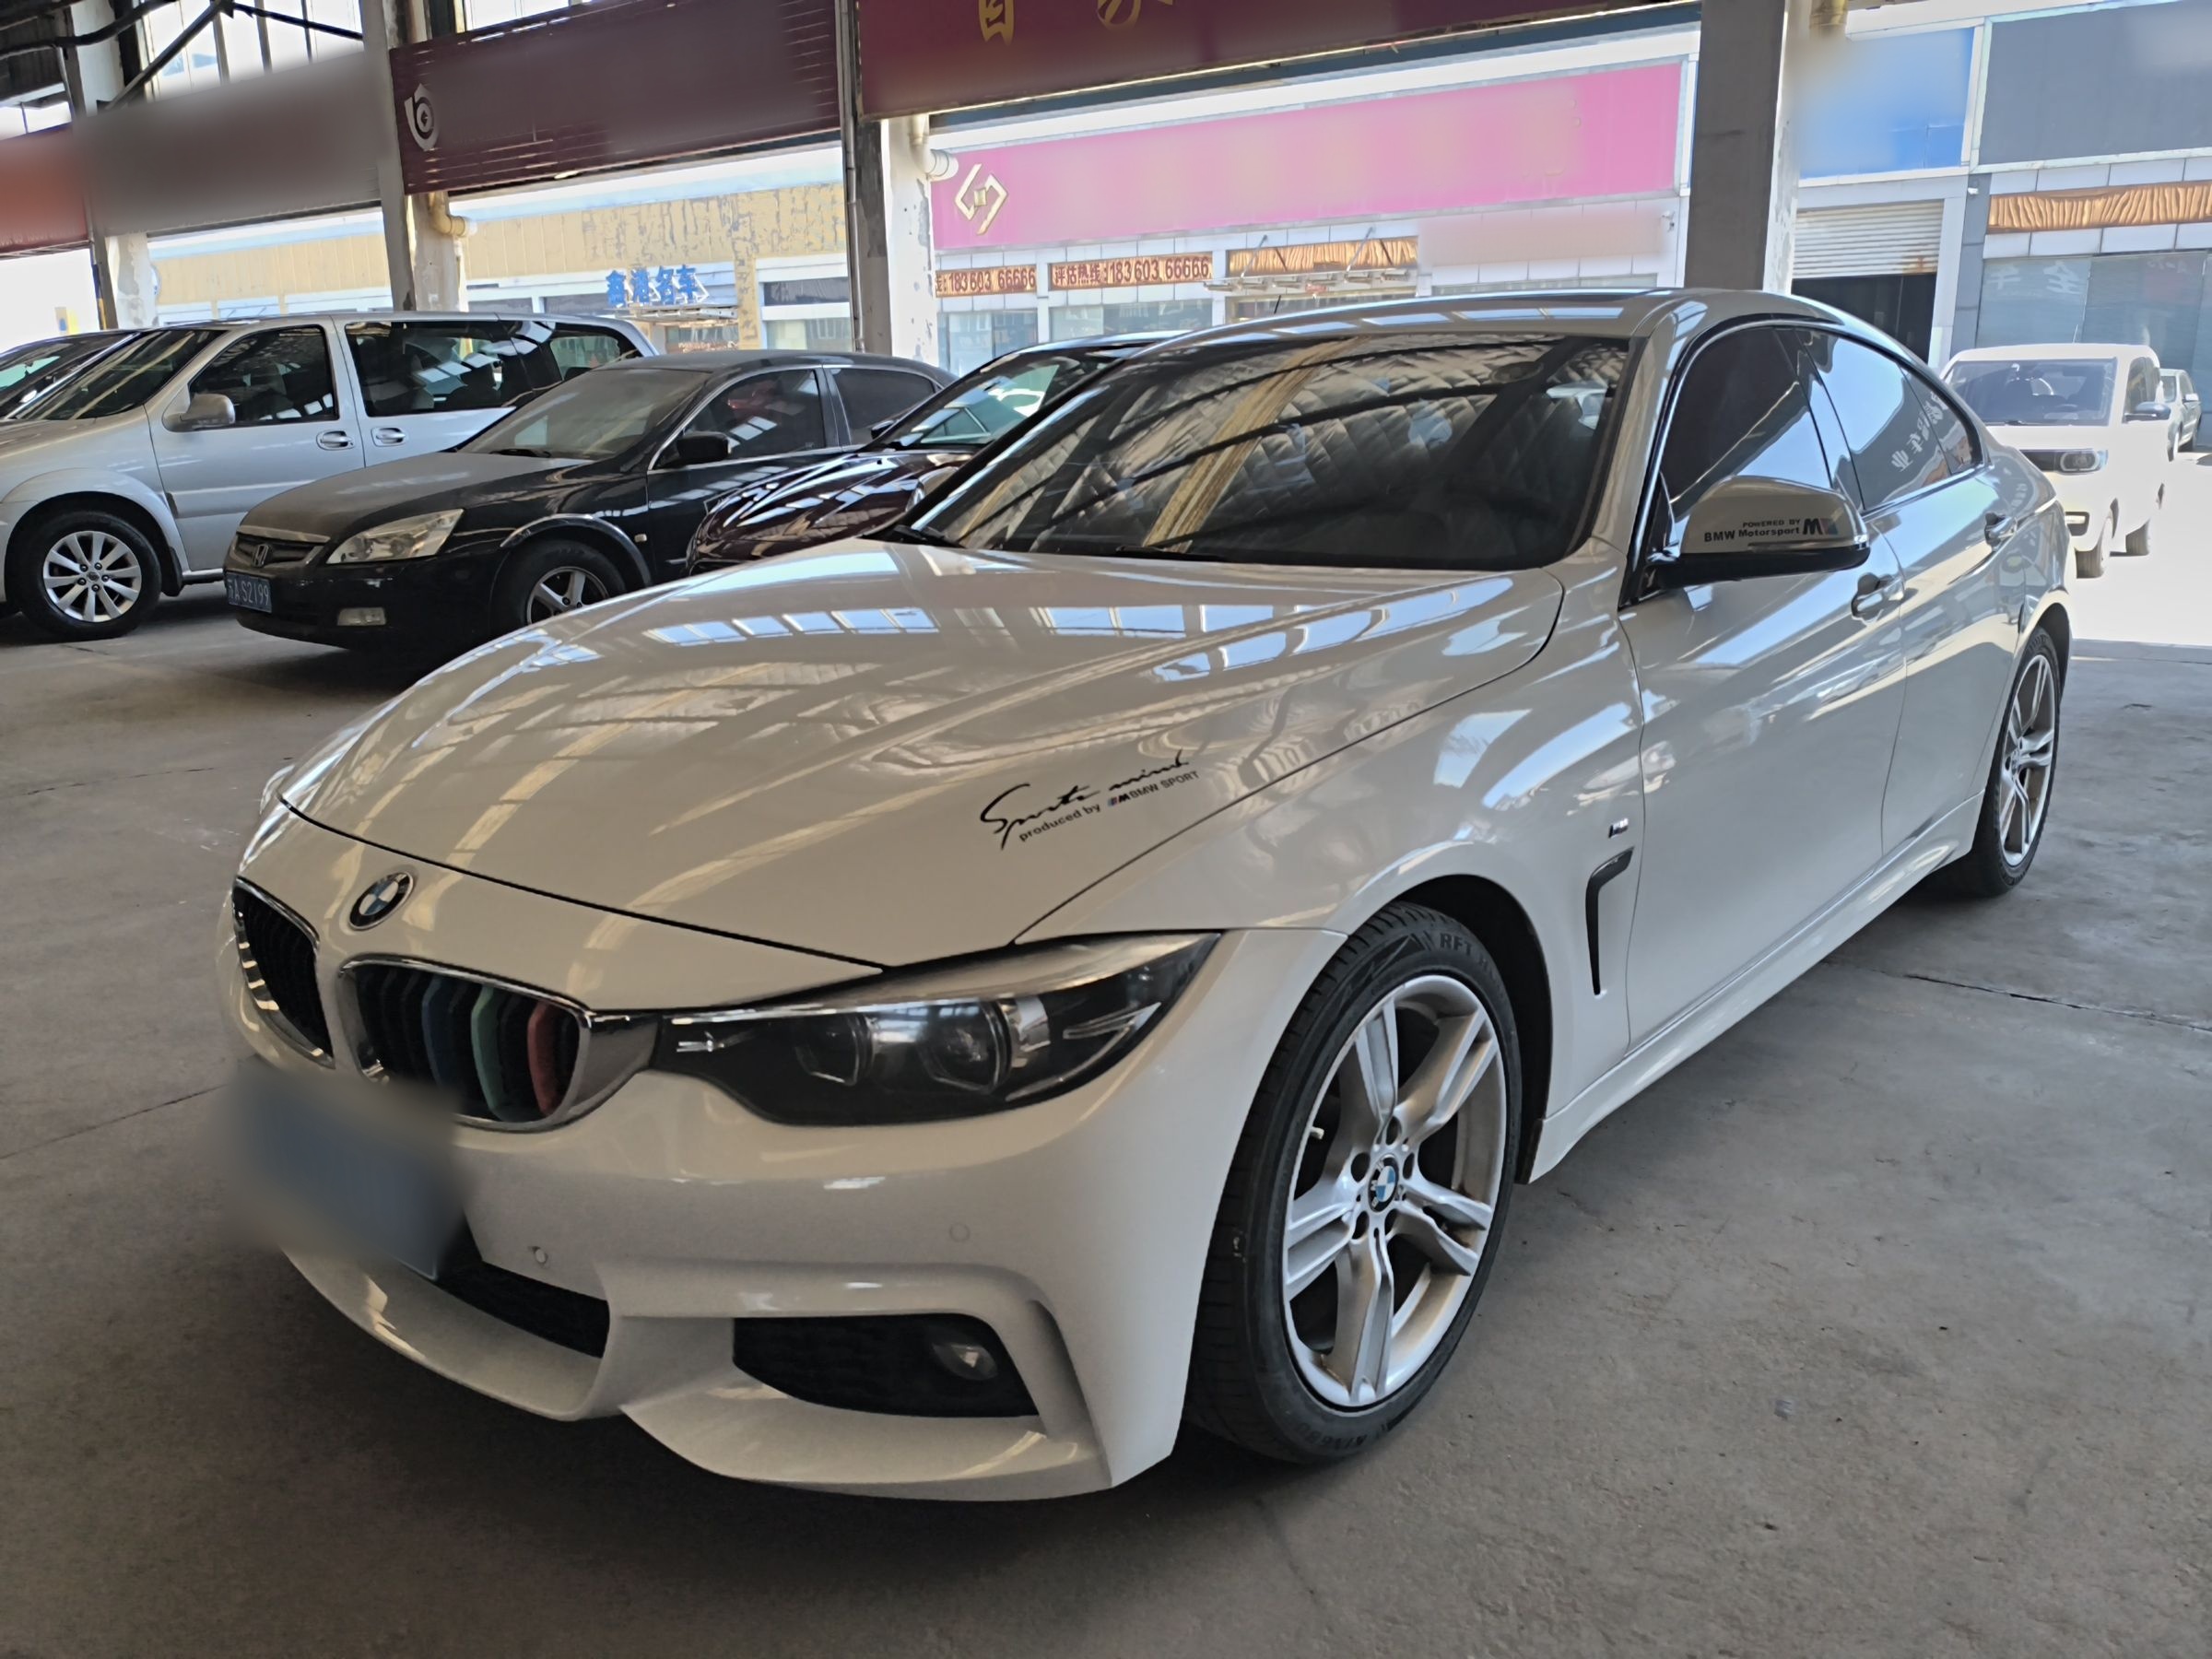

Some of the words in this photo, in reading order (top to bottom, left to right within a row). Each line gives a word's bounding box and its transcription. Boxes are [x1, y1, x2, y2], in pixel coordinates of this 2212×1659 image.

[1742, 519, 1785, 529] POWERED
[1789, 517, 1801, 526] BY
[1703, 530, 1735, 543] BMW
[1738, 525, 1800, 538] Motorsport
[1018, 808, 1083, 843] produced
[1082, 803, 1101, 815] by
[1160, 771, 1200, 789] SPORT
